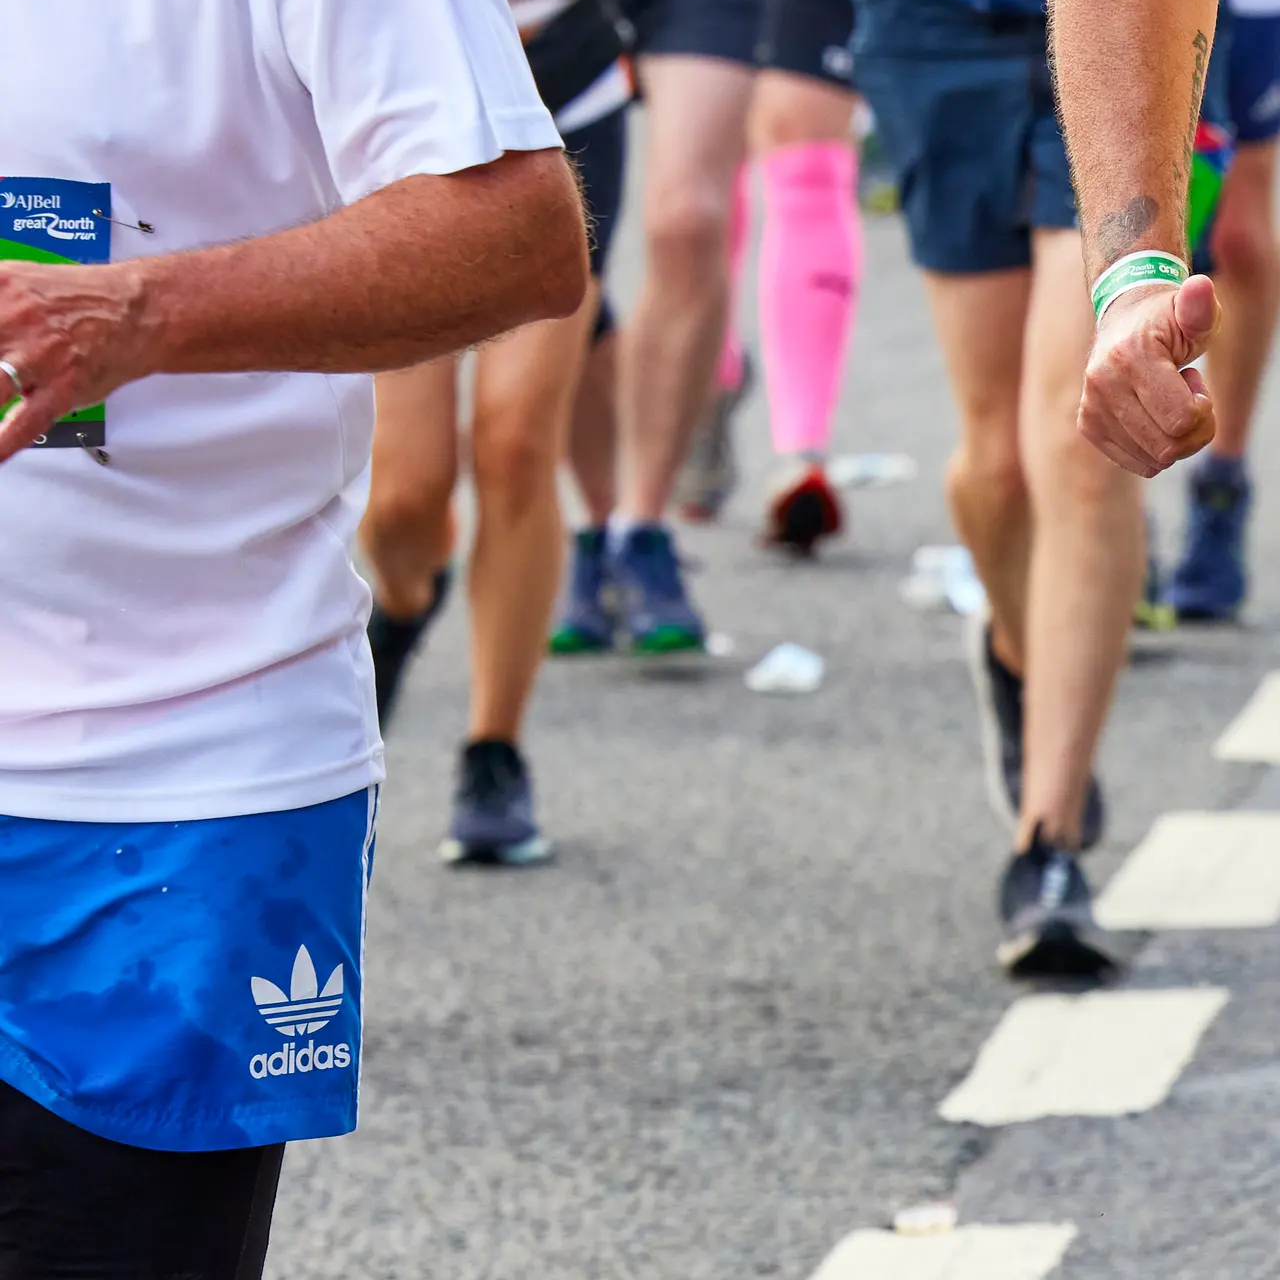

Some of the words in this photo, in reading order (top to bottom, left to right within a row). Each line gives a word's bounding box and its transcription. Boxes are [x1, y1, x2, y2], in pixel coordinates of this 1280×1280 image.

[13, 216, 48, 231] great
[59, 216, 95, 230] north
[73, 232, 96, 240] run
[249, 1039, 351, 1080] adidas
